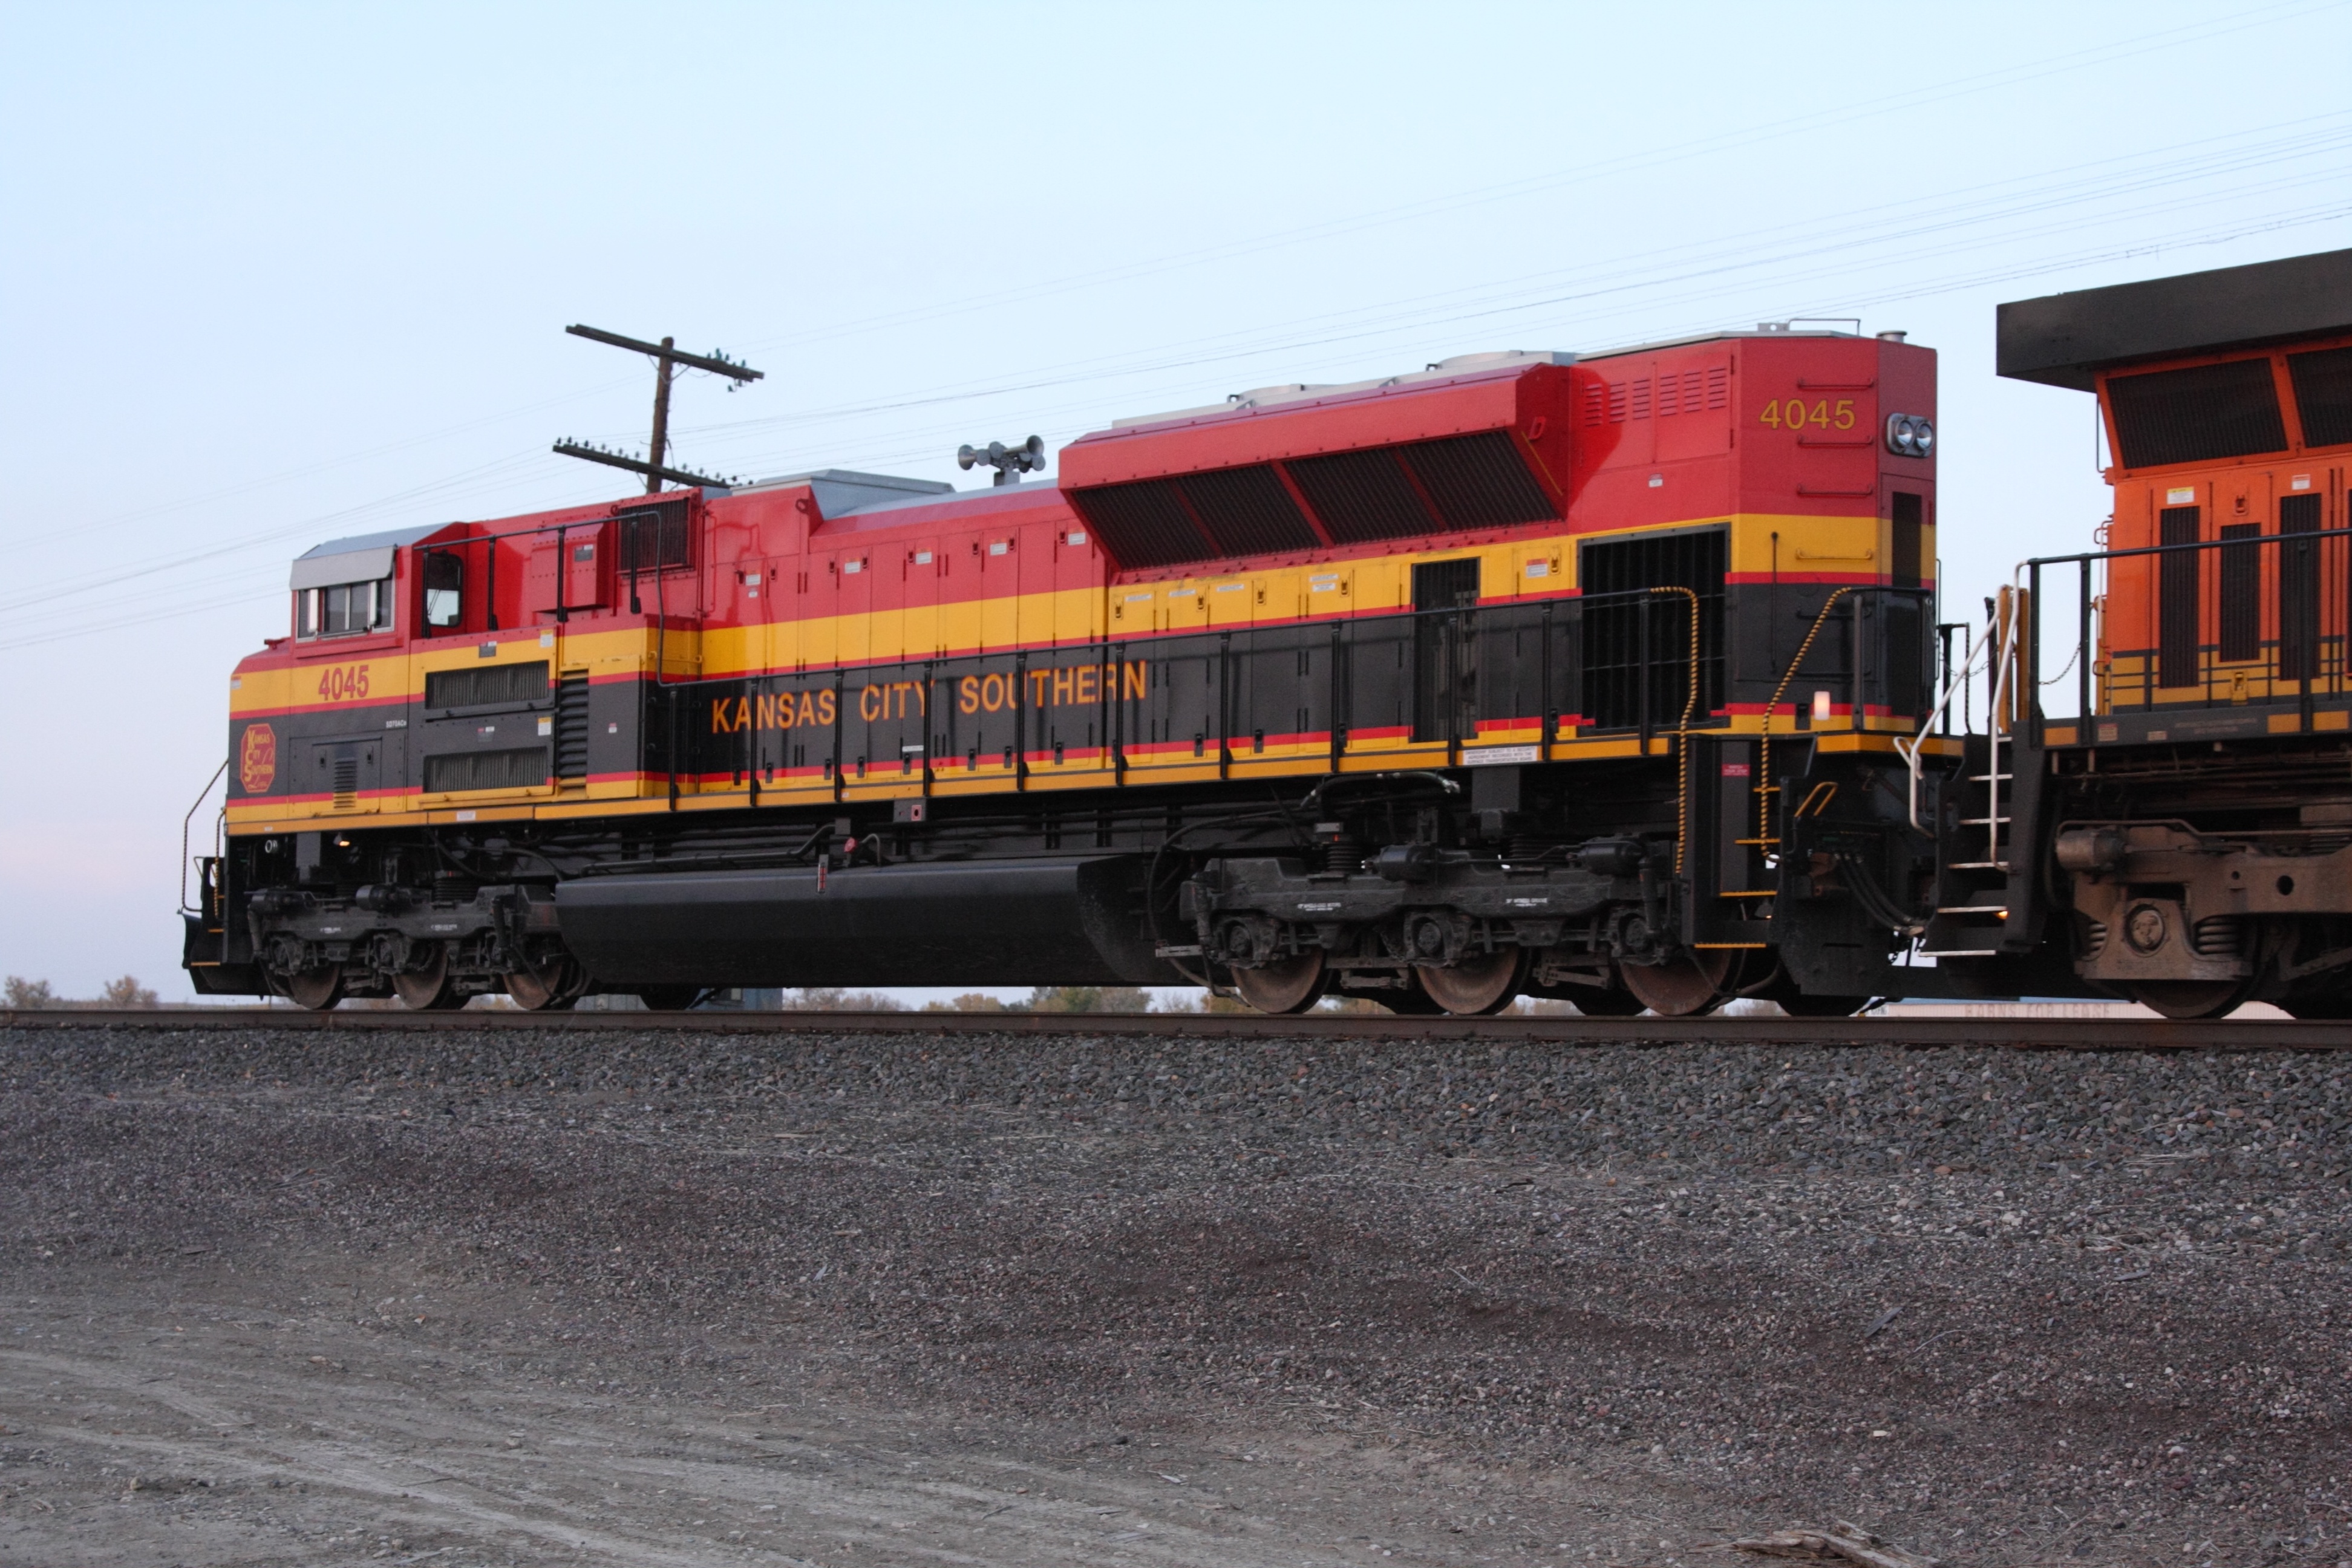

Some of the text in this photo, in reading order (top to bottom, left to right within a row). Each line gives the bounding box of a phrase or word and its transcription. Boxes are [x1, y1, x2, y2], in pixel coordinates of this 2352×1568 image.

[1760, 399, 1855, 430] 4045
[318, 664, 370, 701] 4045
[712, 659, 1147, 734] KANSAS CITY SOUTHERN
